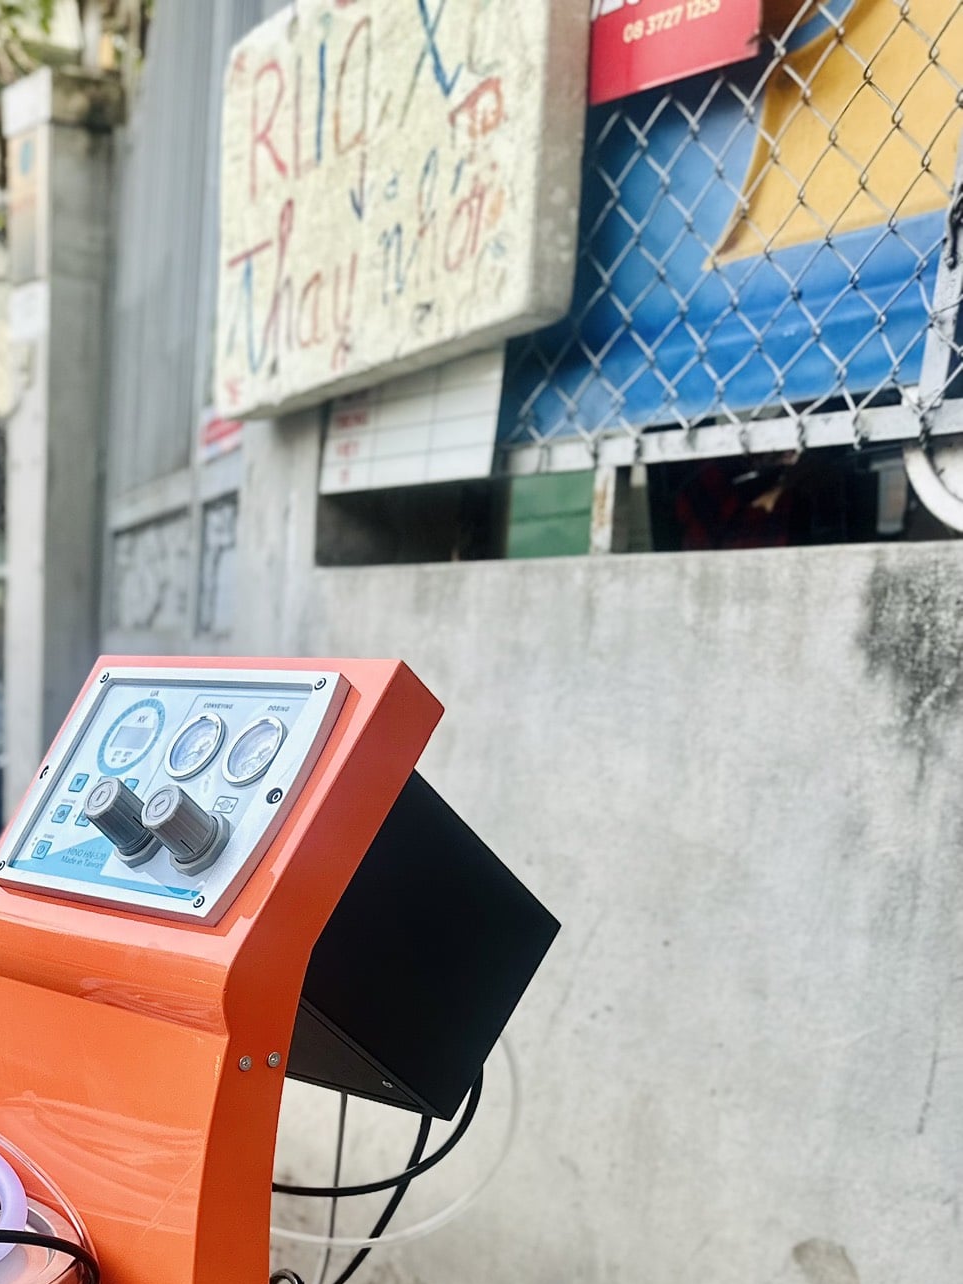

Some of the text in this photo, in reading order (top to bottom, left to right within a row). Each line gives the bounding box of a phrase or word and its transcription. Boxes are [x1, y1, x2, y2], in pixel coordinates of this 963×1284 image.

[623, 19, 645, 43] 08
[645, 5, 684, 36] 3727
[227, 198, 357, 372] Thay
